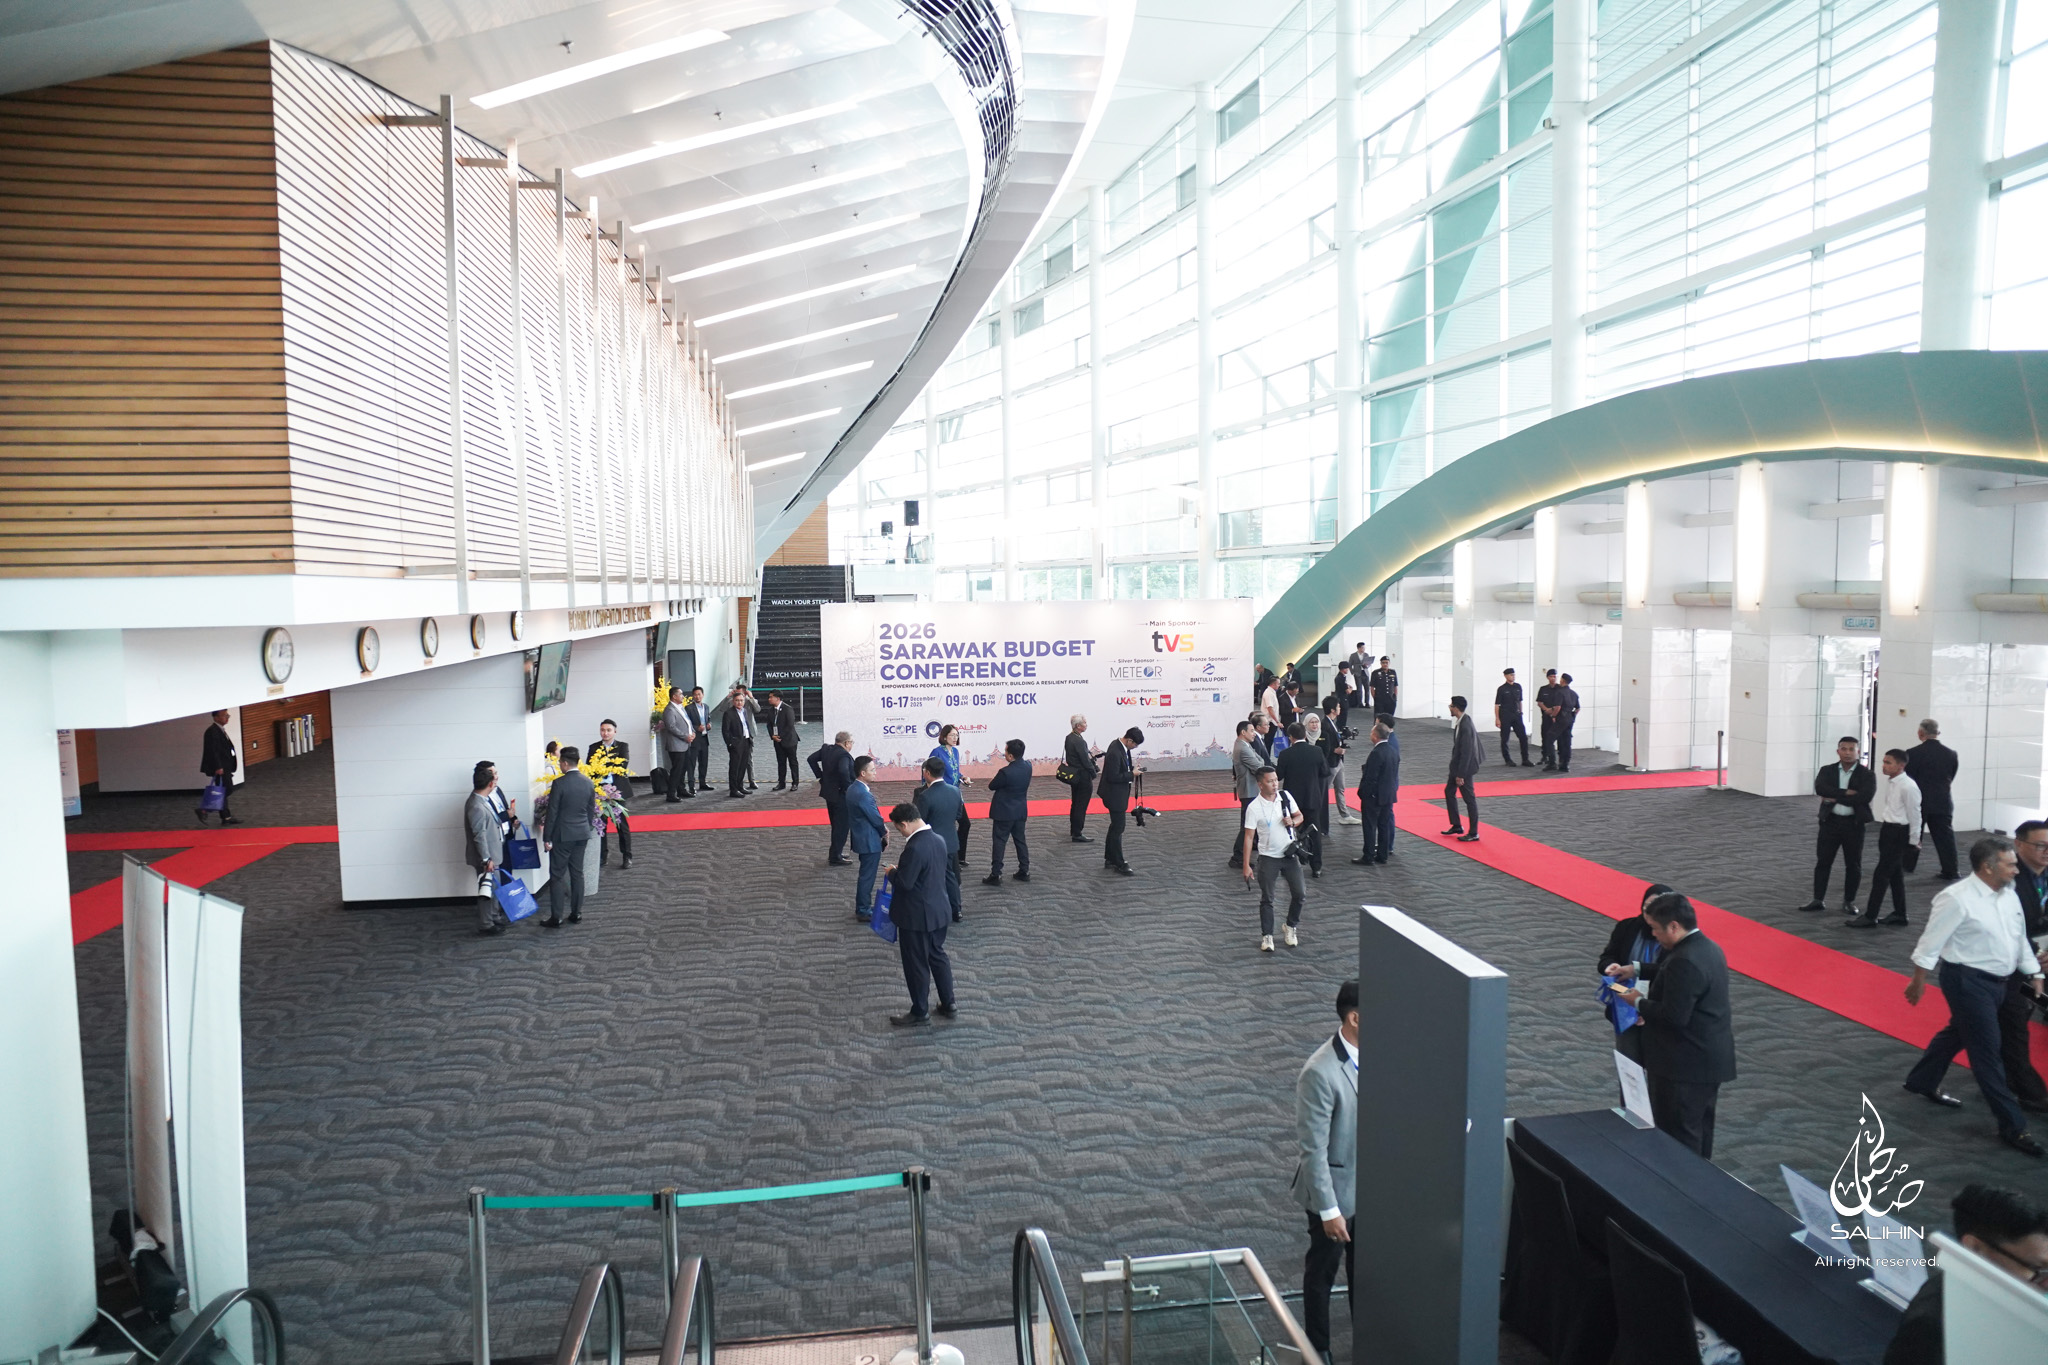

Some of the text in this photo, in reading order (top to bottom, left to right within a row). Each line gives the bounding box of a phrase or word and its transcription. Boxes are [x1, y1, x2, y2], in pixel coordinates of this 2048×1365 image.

[879, 622, 936, 640] 2026
[1152, 630, 1194, 652] tvs
[880, 640, 1096, 660] SARAWAK BUDGET
[880, 661, 1036, 680] CONFERENCE
[881, 696, 909, 708] 16-17
[946, 695, 960, 706] 09
[973, 694, 986, 706] 05
[1006, 693, 1037, 705] BCCK
